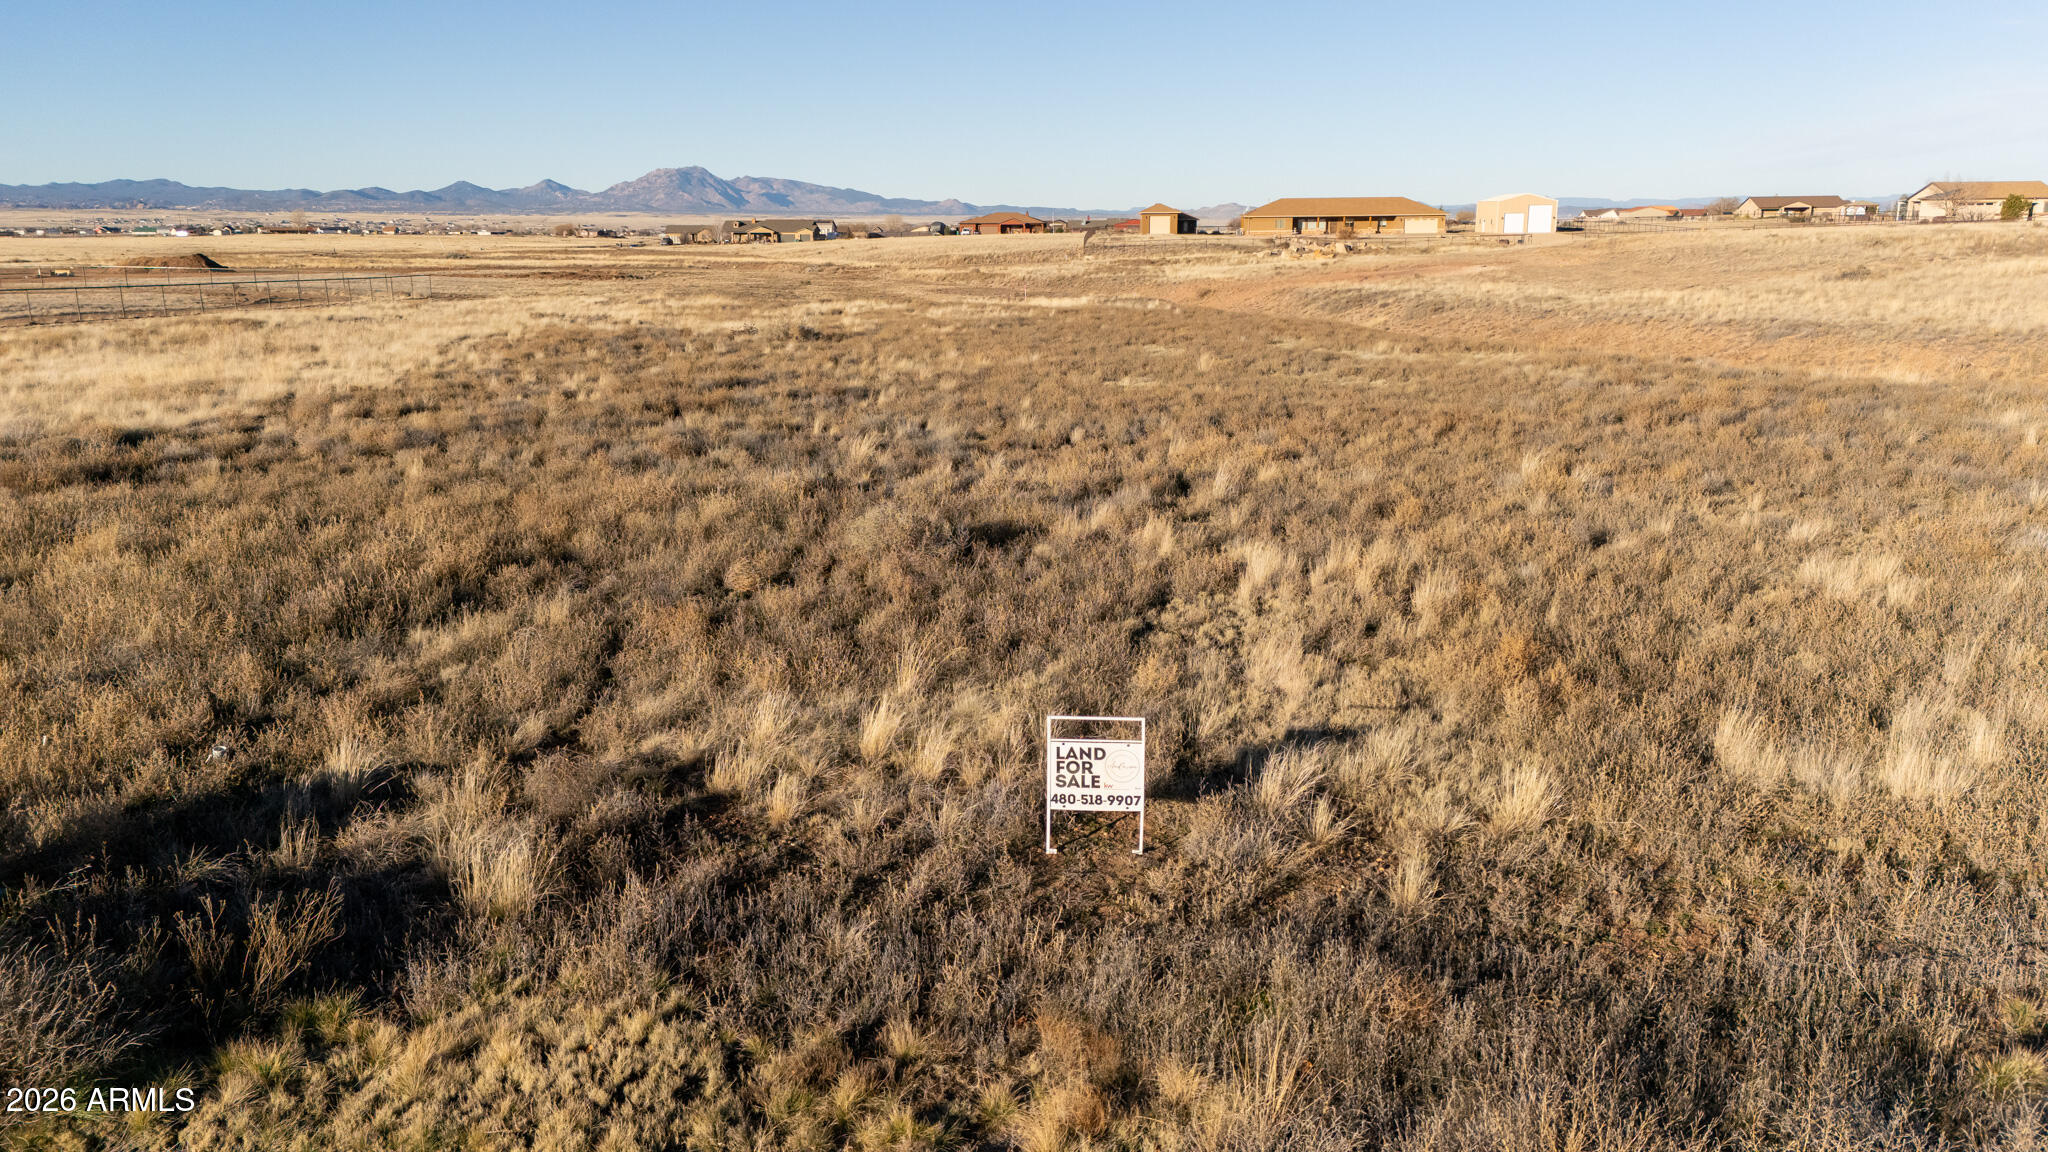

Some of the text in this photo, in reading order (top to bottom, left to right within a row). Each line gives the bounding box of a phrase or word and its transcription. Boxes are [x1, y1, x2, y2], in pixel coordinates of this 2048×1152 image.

[1056, 746, 1106, 760] LAND
[1056, 760, 1093, 774] FOR
[1055, 774, 1101, 788] SALE
[1050, 793, 1141, 806] 480-518-9907
